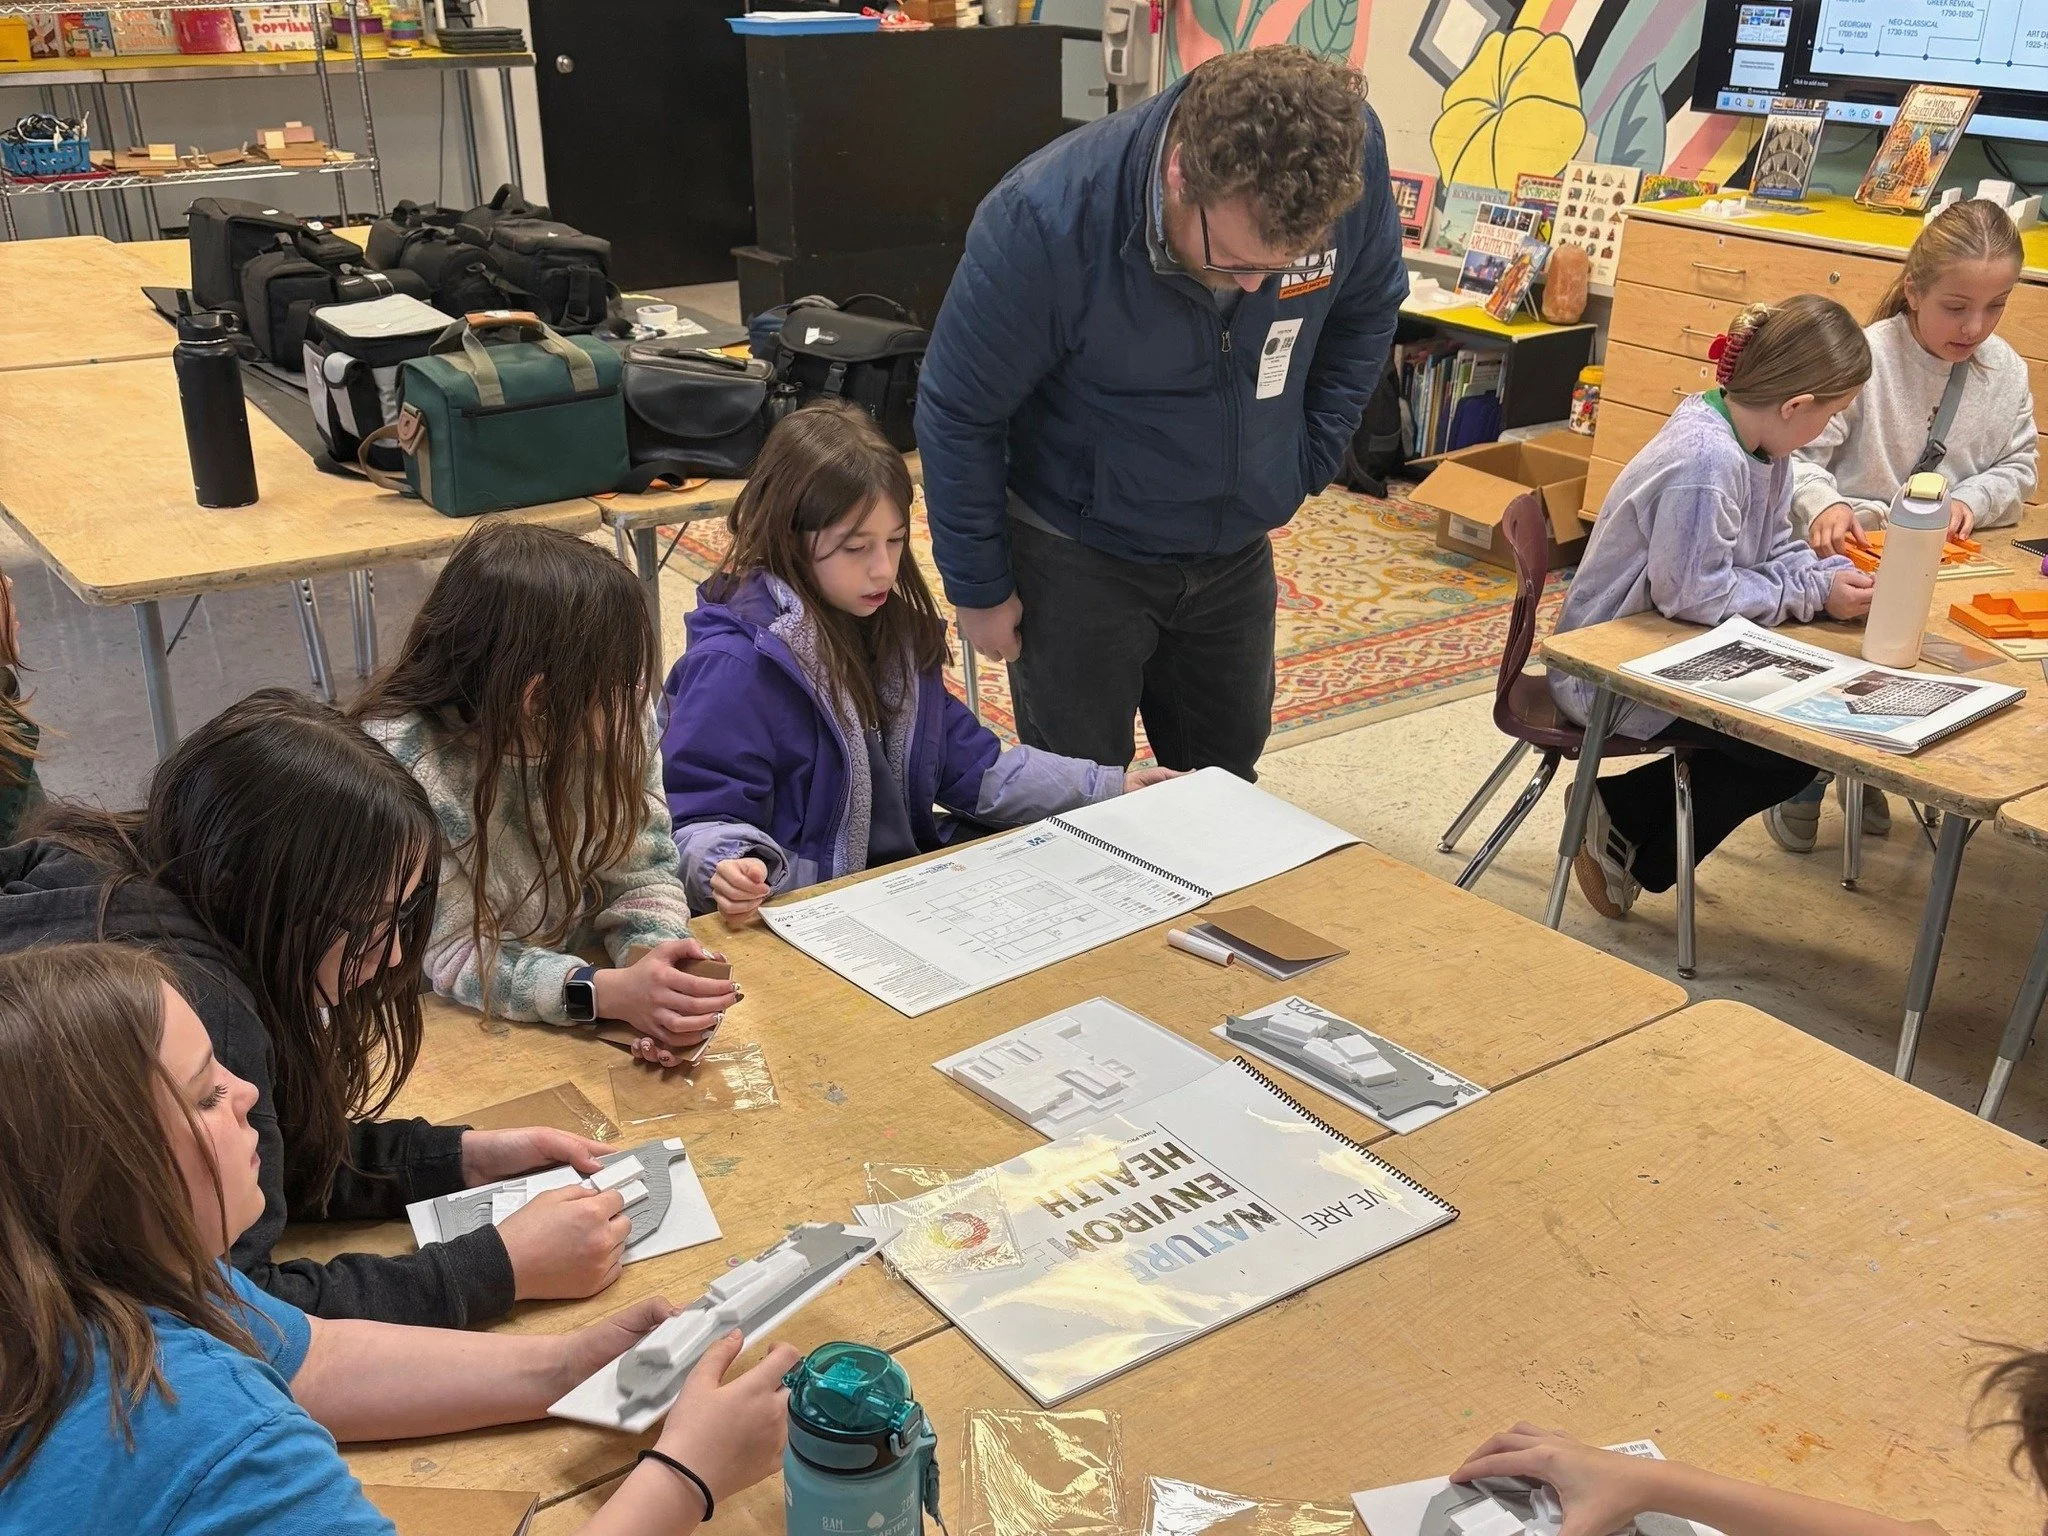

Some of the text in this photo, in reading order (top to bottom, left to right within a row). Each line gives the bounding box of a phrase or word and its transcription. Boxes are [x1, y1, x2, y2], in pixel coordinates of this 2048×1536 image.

[1949, 0, 1975, 8] REVIVAL
[1941, 9, 1974, 18] 1790-1850
[1839, 20, 1871, 28] GEORGIAN
[1888, 18, 1939, 28] NEO-CLASSICAL
[1585, 188, 1609, 205] Home
[1034, 1141, 1196, 1219] HEALTH
[1301, 1199, 1355, 1232] ARE
[822, 1516, 843, 1530] 8AM
